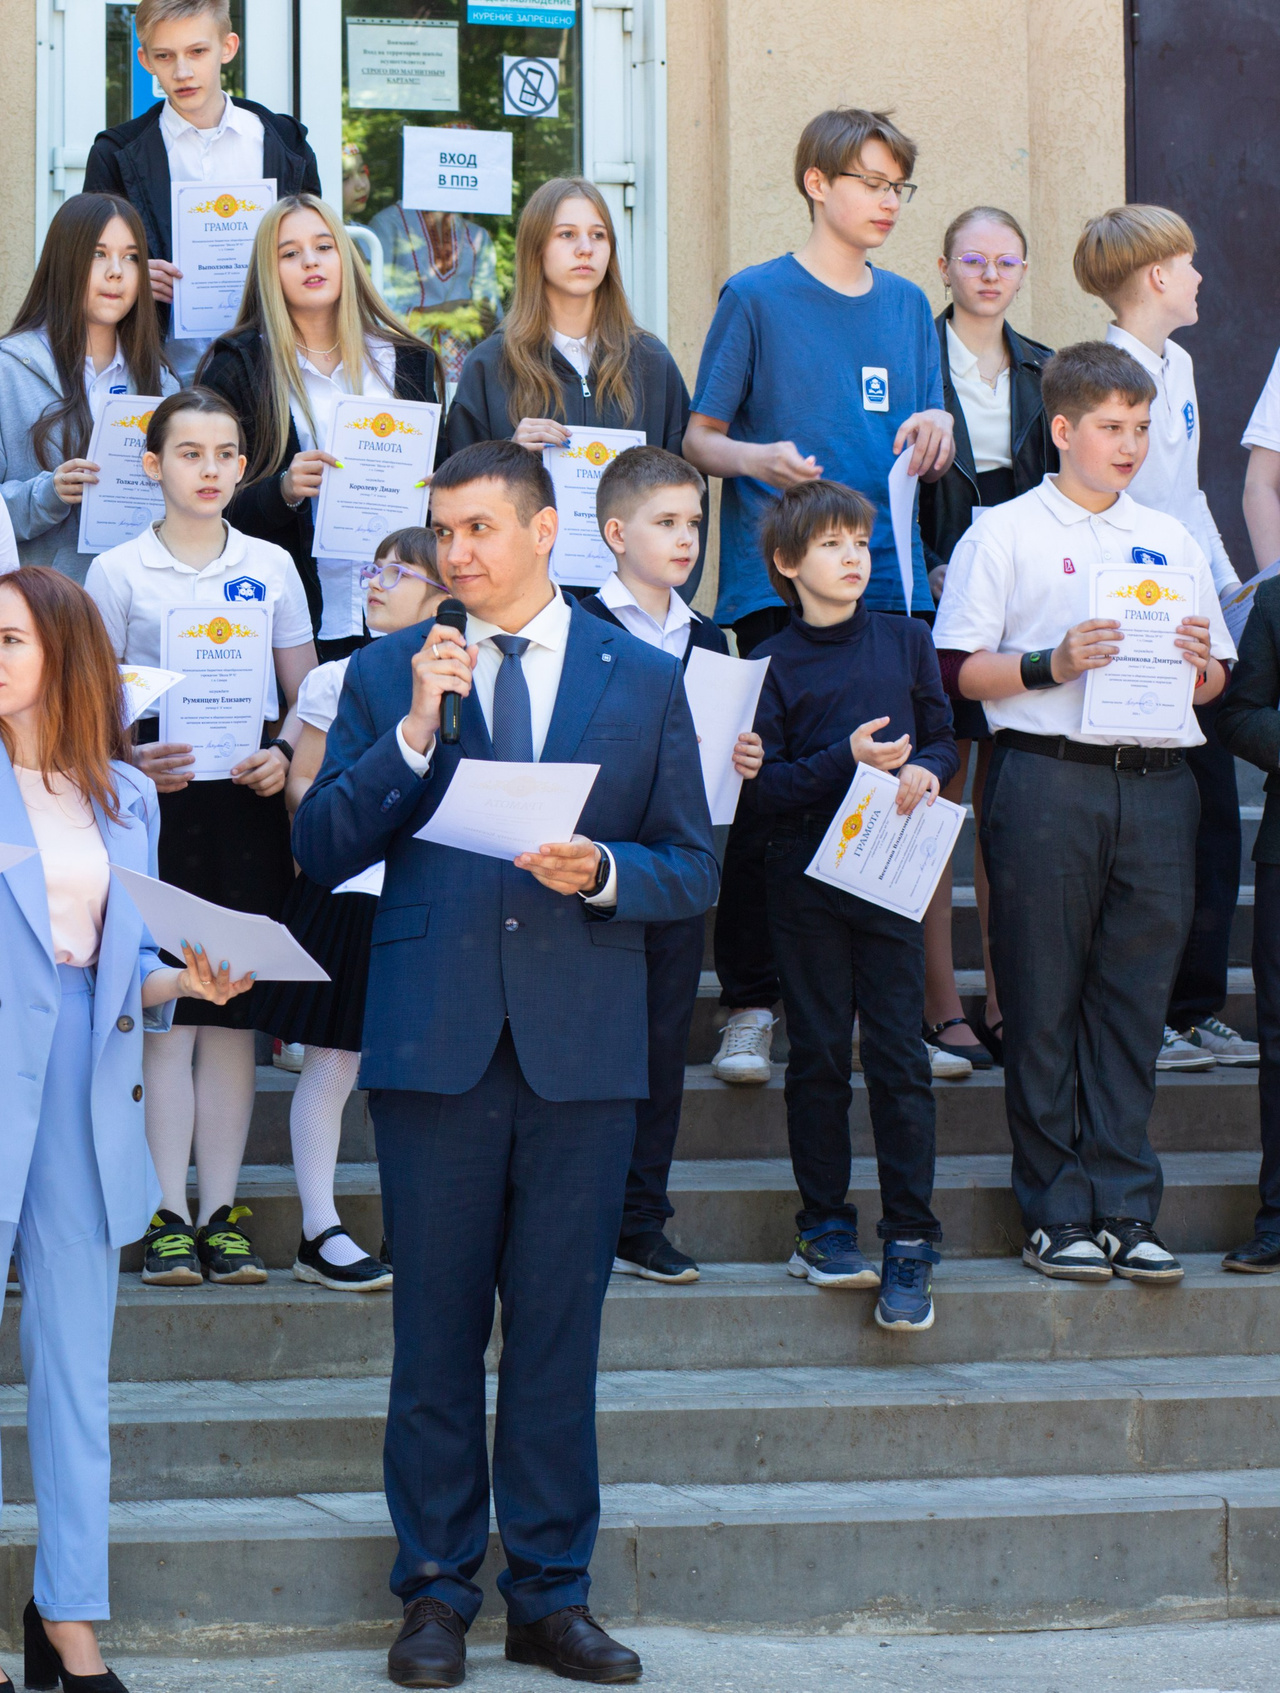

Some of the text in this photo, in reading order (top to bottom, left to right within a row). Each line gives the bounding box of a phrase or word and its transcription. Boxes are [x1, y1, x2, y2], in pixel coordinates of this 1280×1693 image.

[473, 12, 572, 25] КУРЕНИЕ ЗАПРЕЩЕНО
[439, 152, 477, 167] ВХОД
[438, 174, 478, 188] В ППЭ
[204, 222, 248, 232] ГРАМОТА
[234, 263, 250, 271] Заха
[358, 440, 402, 453] ГРАМОТА
[116, 478, 139, 486] Толкач
[349, 483, 400, 494] Королеву Диану
[1125, 609, 1170, 622] ГРАМОТА
[196, 649, 242, 659] ГРАМОТА
[1152, 655, 1184, 665] Дмитрия
[182, 697, 219, 705] Румянцеву
[854, 810, 881, 857] ГРАМОТА
[878, 850, 895, 881] Веселова
